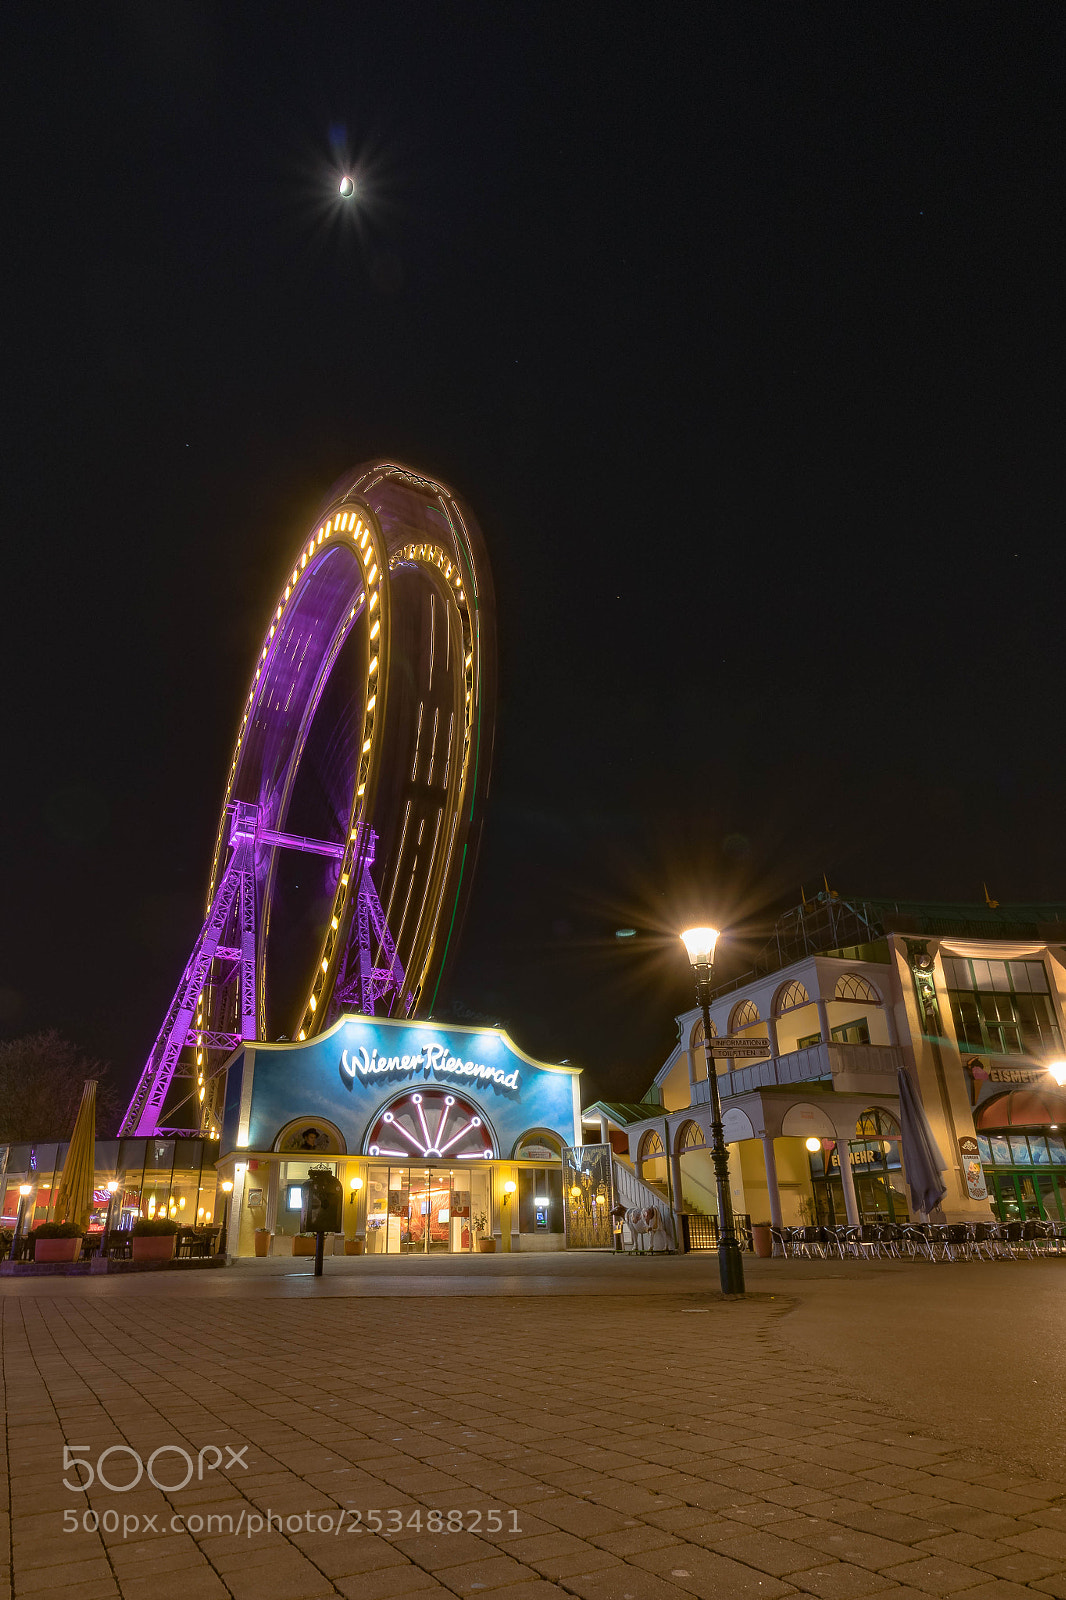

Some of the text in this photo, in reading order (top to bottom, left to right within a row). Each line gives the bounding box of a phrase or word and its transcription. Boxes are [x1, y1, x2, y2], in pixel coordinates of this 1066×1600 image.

[342, 1044, 520, 1090] Wiener Riesenrad
[831, 1150, 875, 1167] EIMEHR
